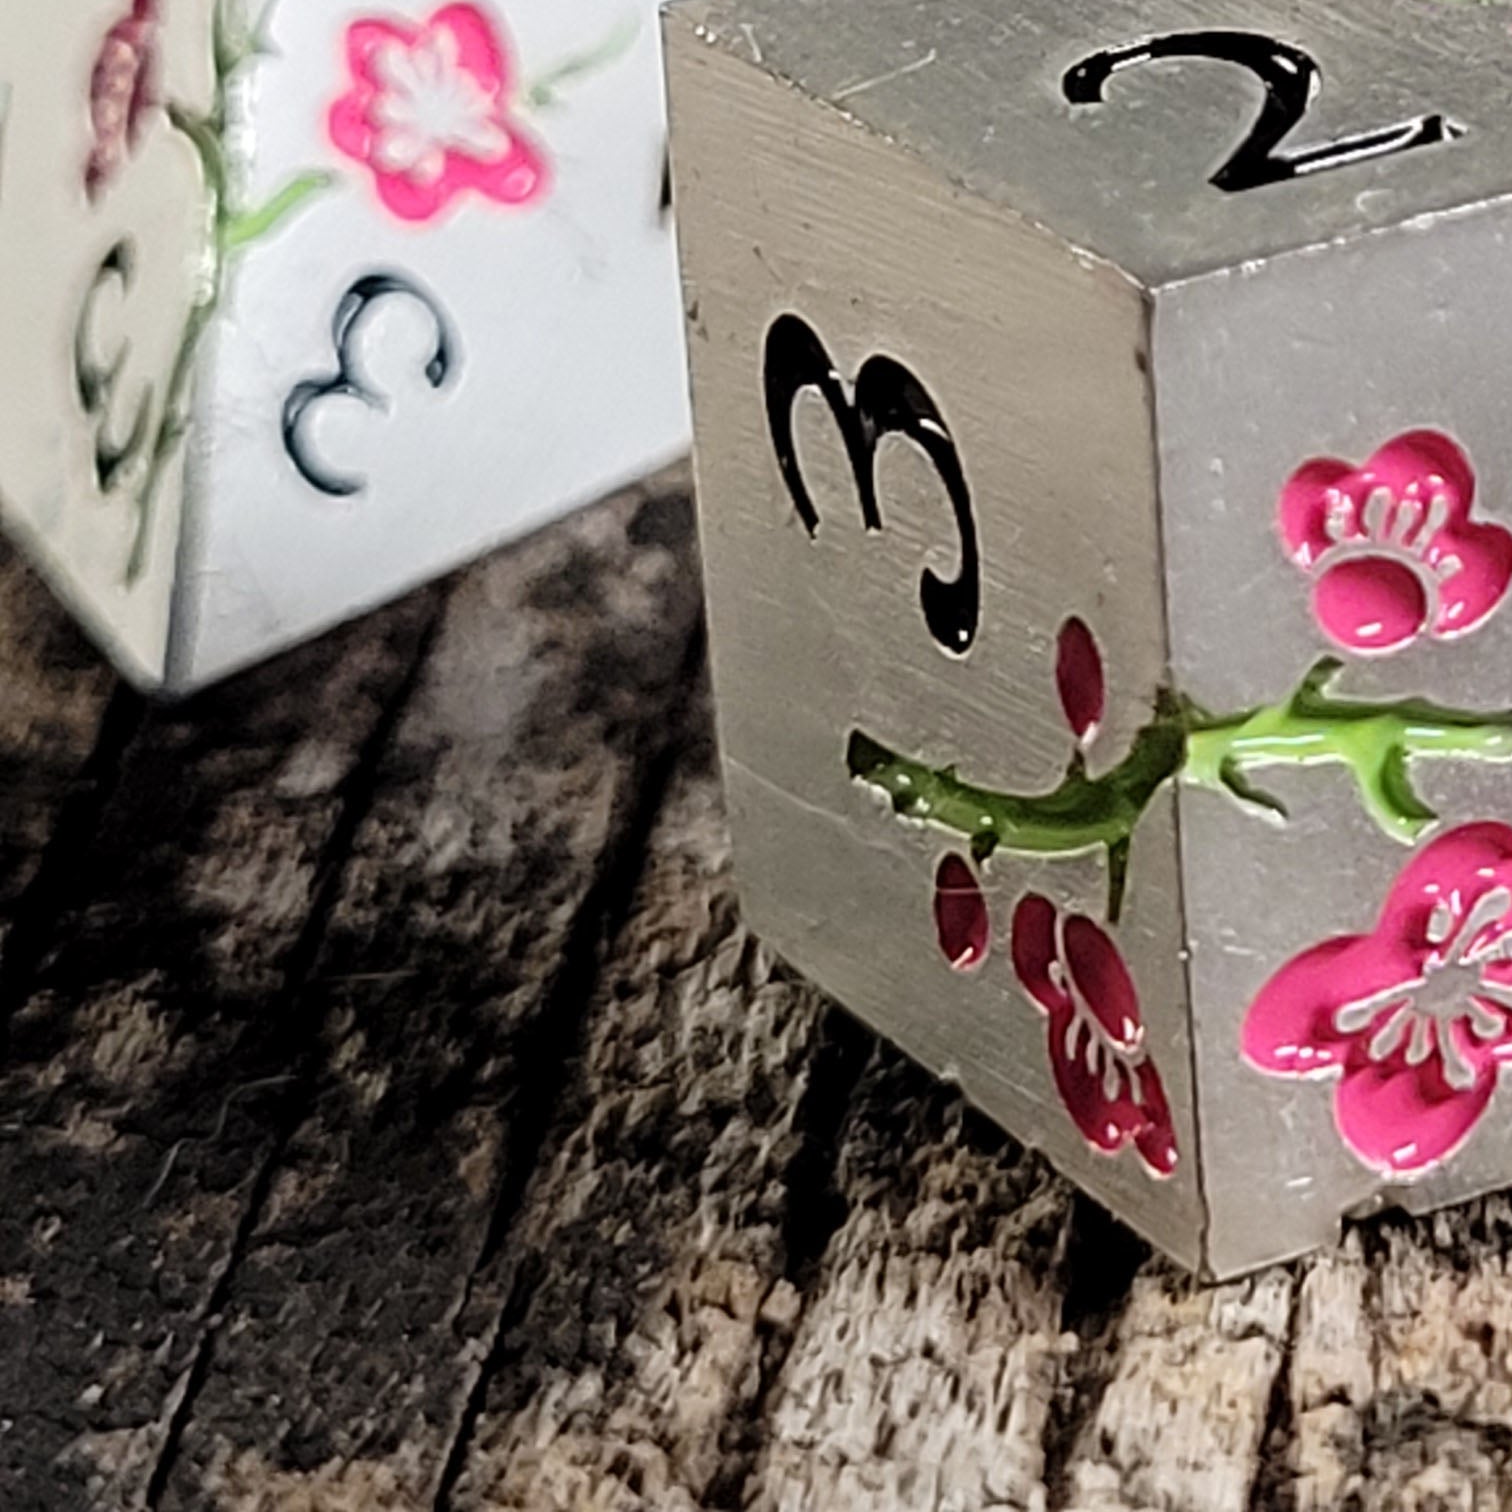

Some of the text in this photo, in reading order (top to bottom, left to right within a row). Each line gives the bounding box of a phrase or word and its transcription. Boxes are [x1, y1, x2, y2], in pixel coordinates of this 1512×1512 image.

[1061, 30, 1460, 192] 2
[280, 274, 462, 498] 3
[762, 313, 982, 660] 3
